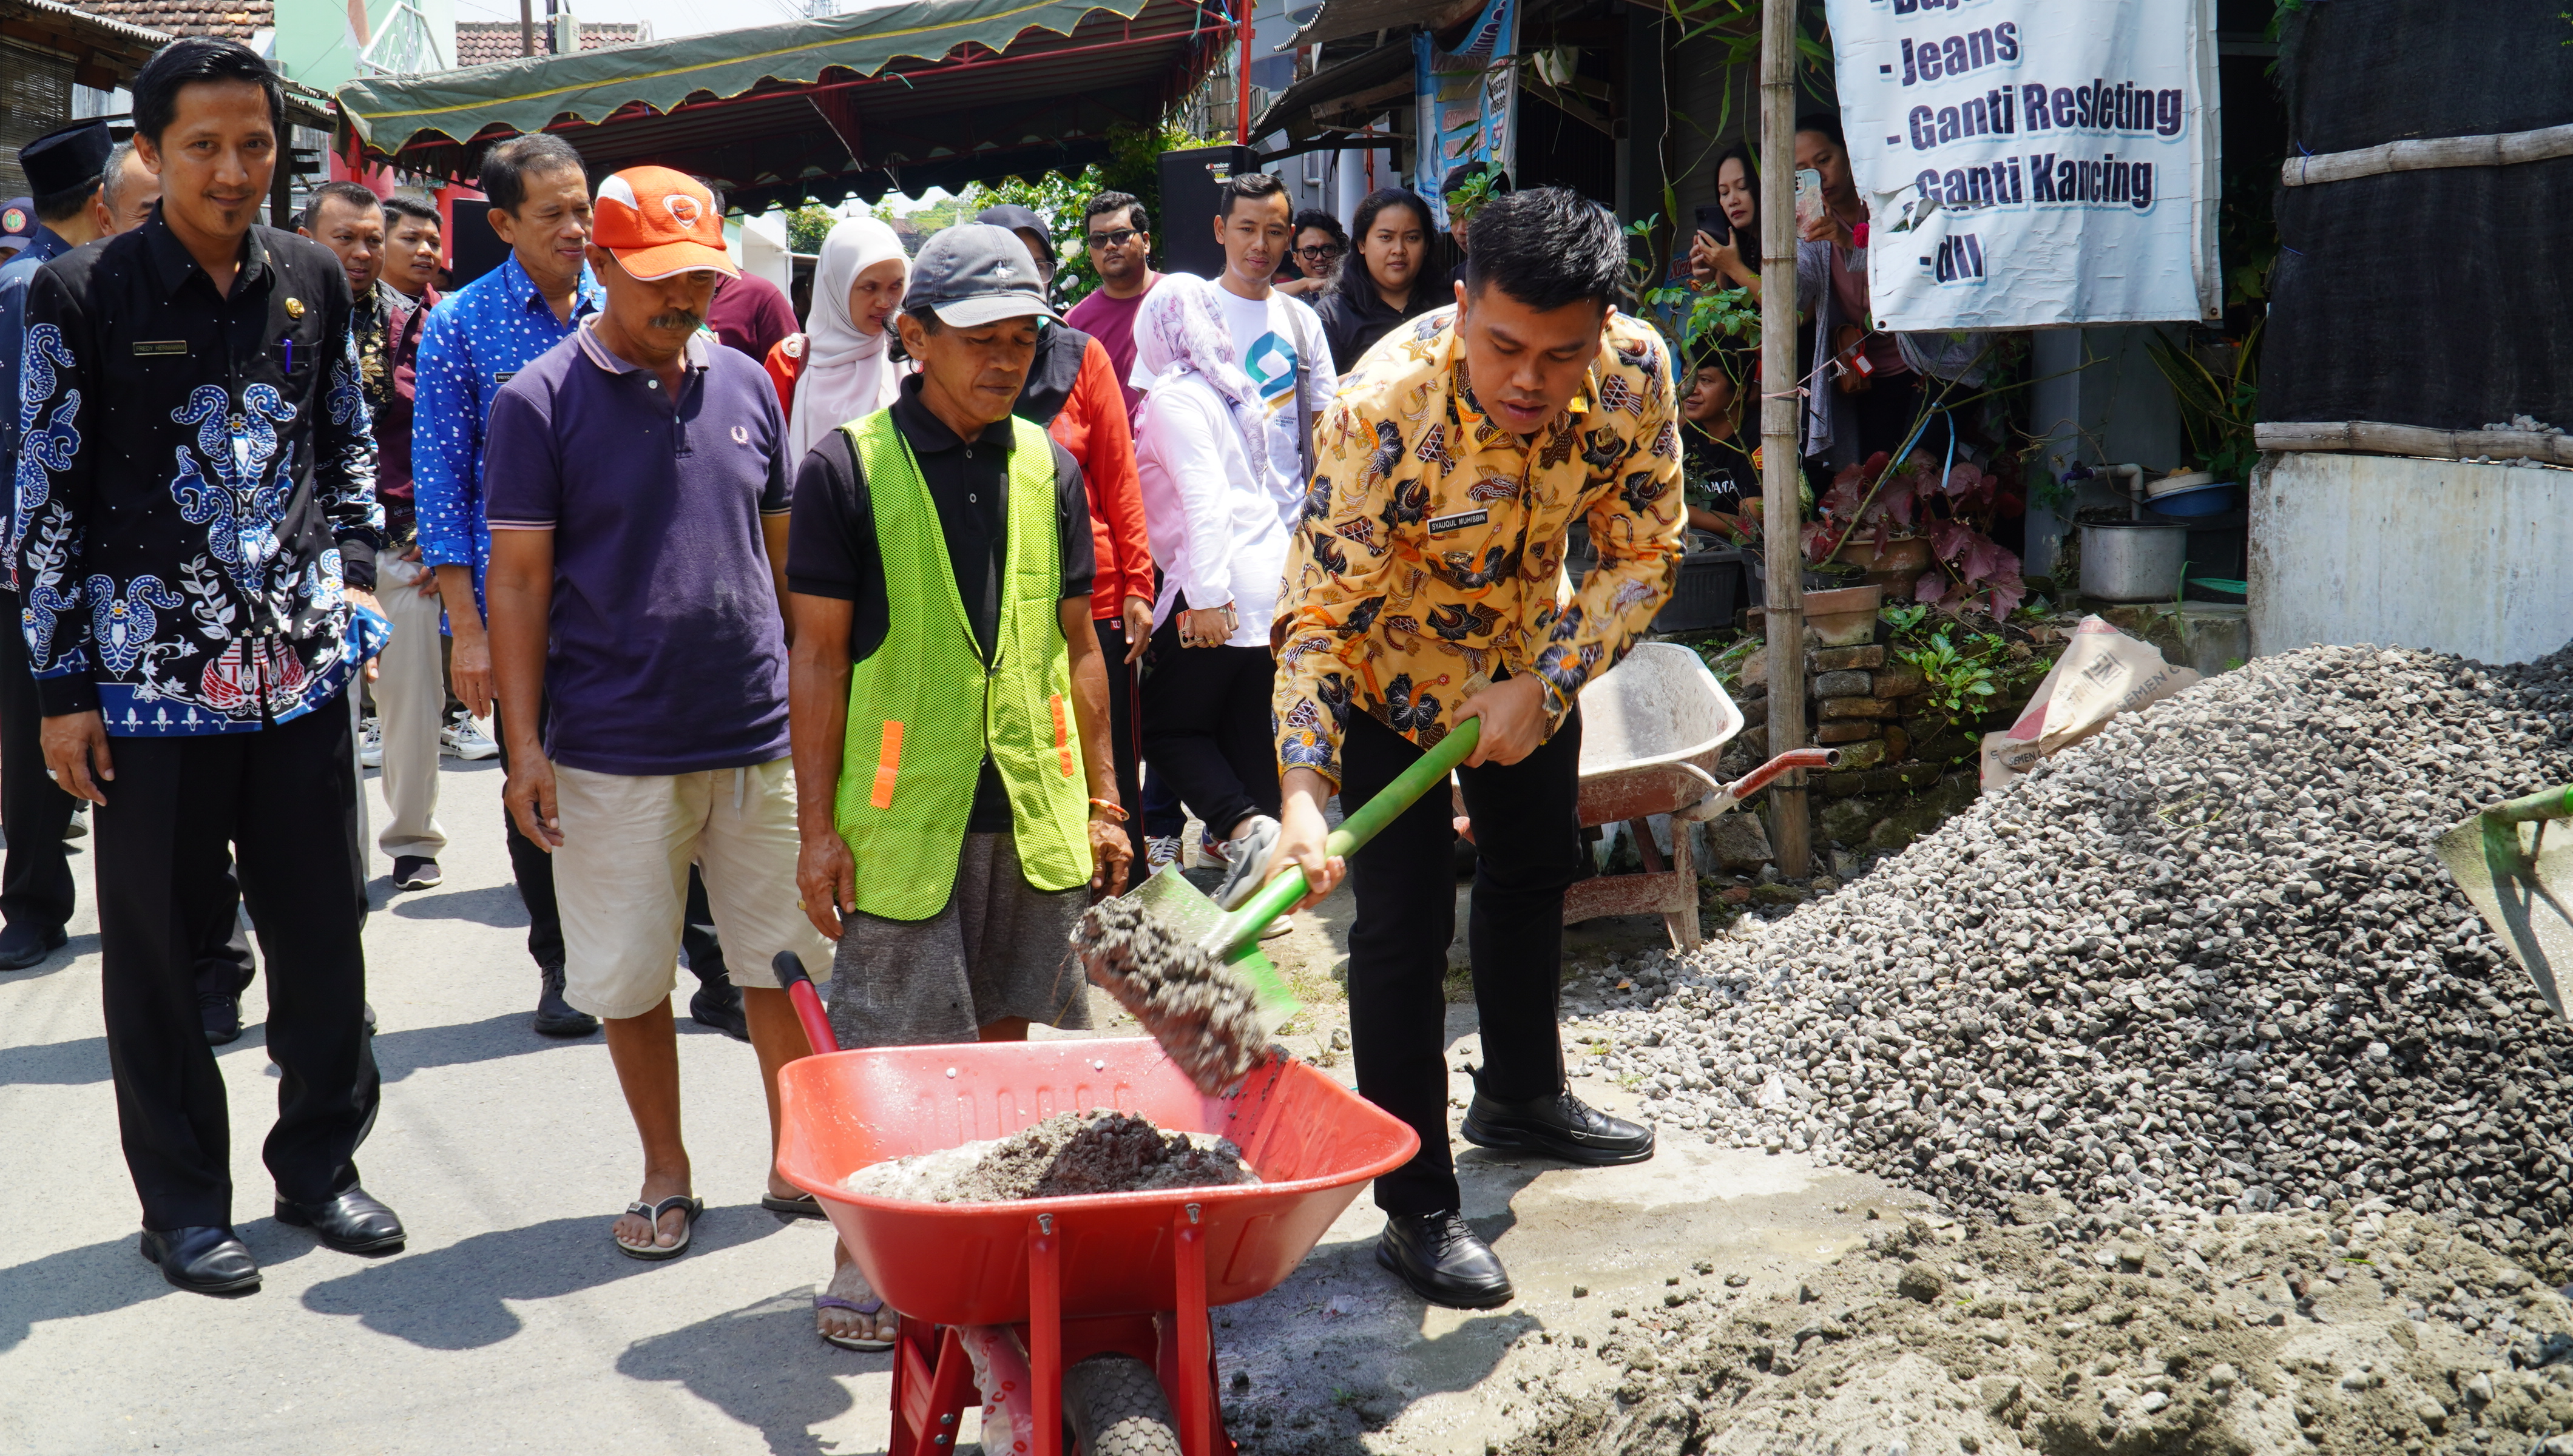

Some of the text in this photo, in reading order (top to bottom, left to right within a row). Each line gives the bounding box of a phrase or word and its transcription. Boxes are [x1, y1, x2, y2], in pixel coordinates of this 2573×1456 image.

[1901, 21, 2018, 86] Jeans
[1909, 85, 2014, 150] Ganti
[2022, 78, 2182, 135] Resleting
[1916, 157, 2023, 212] Ganti
[2030, 153, 2152, 209] Kancing
[1936, 234, 1983, 283] dll
[1432, 514, 1486, 531] SYAUQUL MUHIBBIN
[2115, 670, 2168, 711] SEMEN
[2009, 751, 2037, 766] SEMEN
